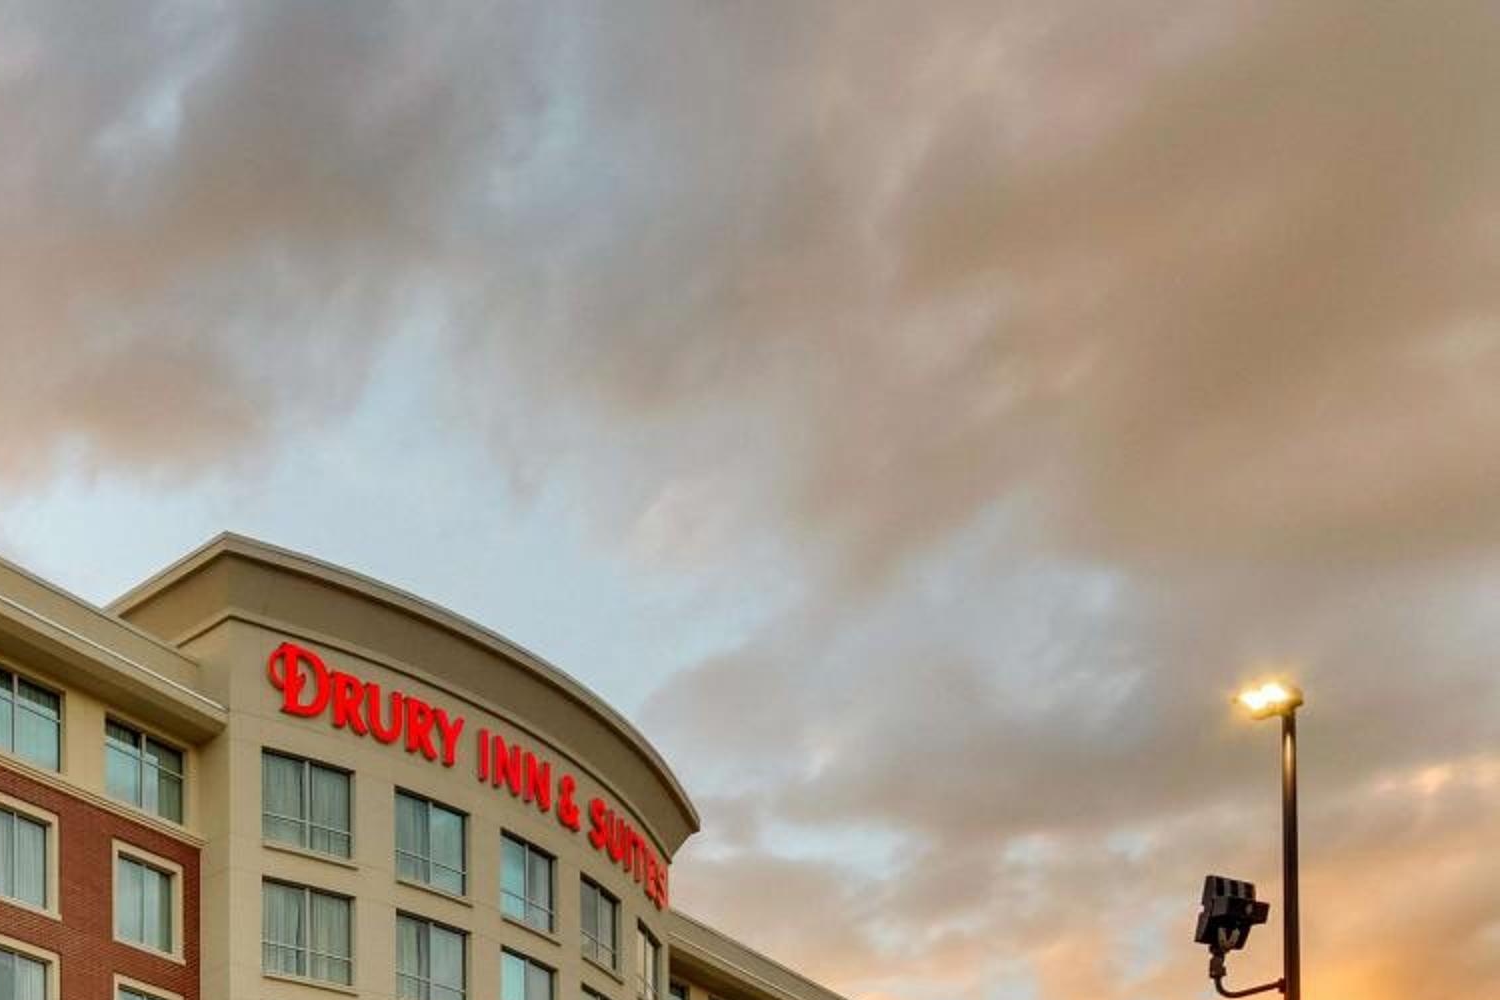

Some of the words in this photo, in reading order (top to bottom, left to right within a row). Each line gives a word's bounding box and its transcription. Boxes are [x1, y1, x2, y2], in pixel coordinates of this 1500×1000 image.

[268, 642, 465, 768] DRURY
[477, 727, 551, 813] INN
[558, 774, 581, 832] &
[588, 798, 669, 911] SUITES
